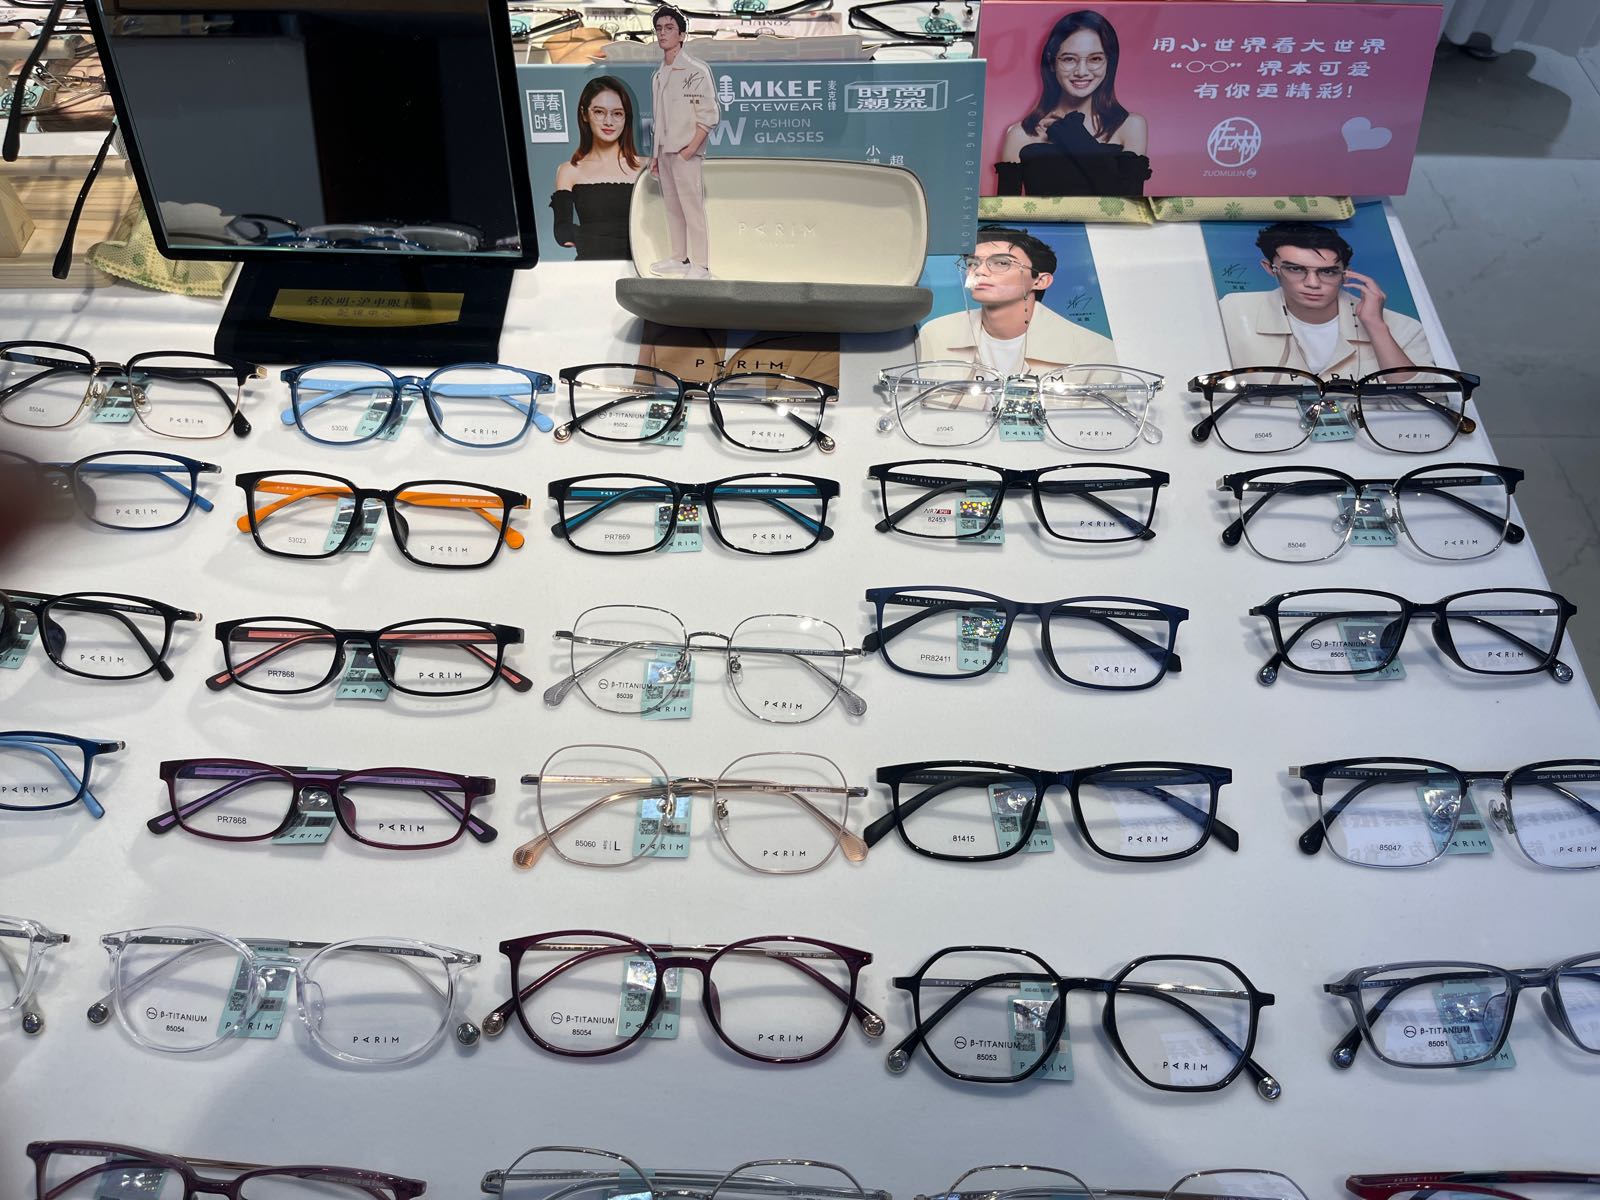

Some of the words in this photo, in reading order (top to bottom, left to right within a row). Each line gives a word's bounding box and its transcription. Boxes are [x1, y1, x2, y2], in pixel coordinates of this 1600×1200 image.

[1152, 38, 1386, 54] 用小世界看大世界
[1257, 61, 1371, 76] 界本可爱
[740, 80, 822, 97] MKEF
[858, 86, 926, 98] 时尚
[828, 80, 837, 112] 麦克锋
[532, 94, 560, 110] 青春
[740, 102, 823, 112] EYEWEAR
[857, 99, 928, 110] 潮流
[534, 114, 562, 132] 时髦
[754, 118, 811, 128] FASHION
[966, 101, 976, 148] YOUNG
[754, 132, 824, 144] GLASSES
[961, 186, 972, 246] FASHION
[738, 222, 816, 237] PARIM
[695, 358, 784, 370] PARIM
[464, 427, 498, 435] PARIM
[752, 430, 784, 438] PARIM
[430, 545, 468, 553] PARIM
[964, 658, 1003, 667] PARM
[764, 701, 802, 709] PARIM
[217, 816, 246, 824] PR7868
[378, 824, 424, 832] PARIM
[614, 841, 620, 850] L
[224, 1021, 273, 1031] PRIM
[353, 1036, 400, 1044] PARIM
[1020, 1062, 1066, 1072] PRIM
[1163, 1062, 1208, 1070] PARIM
